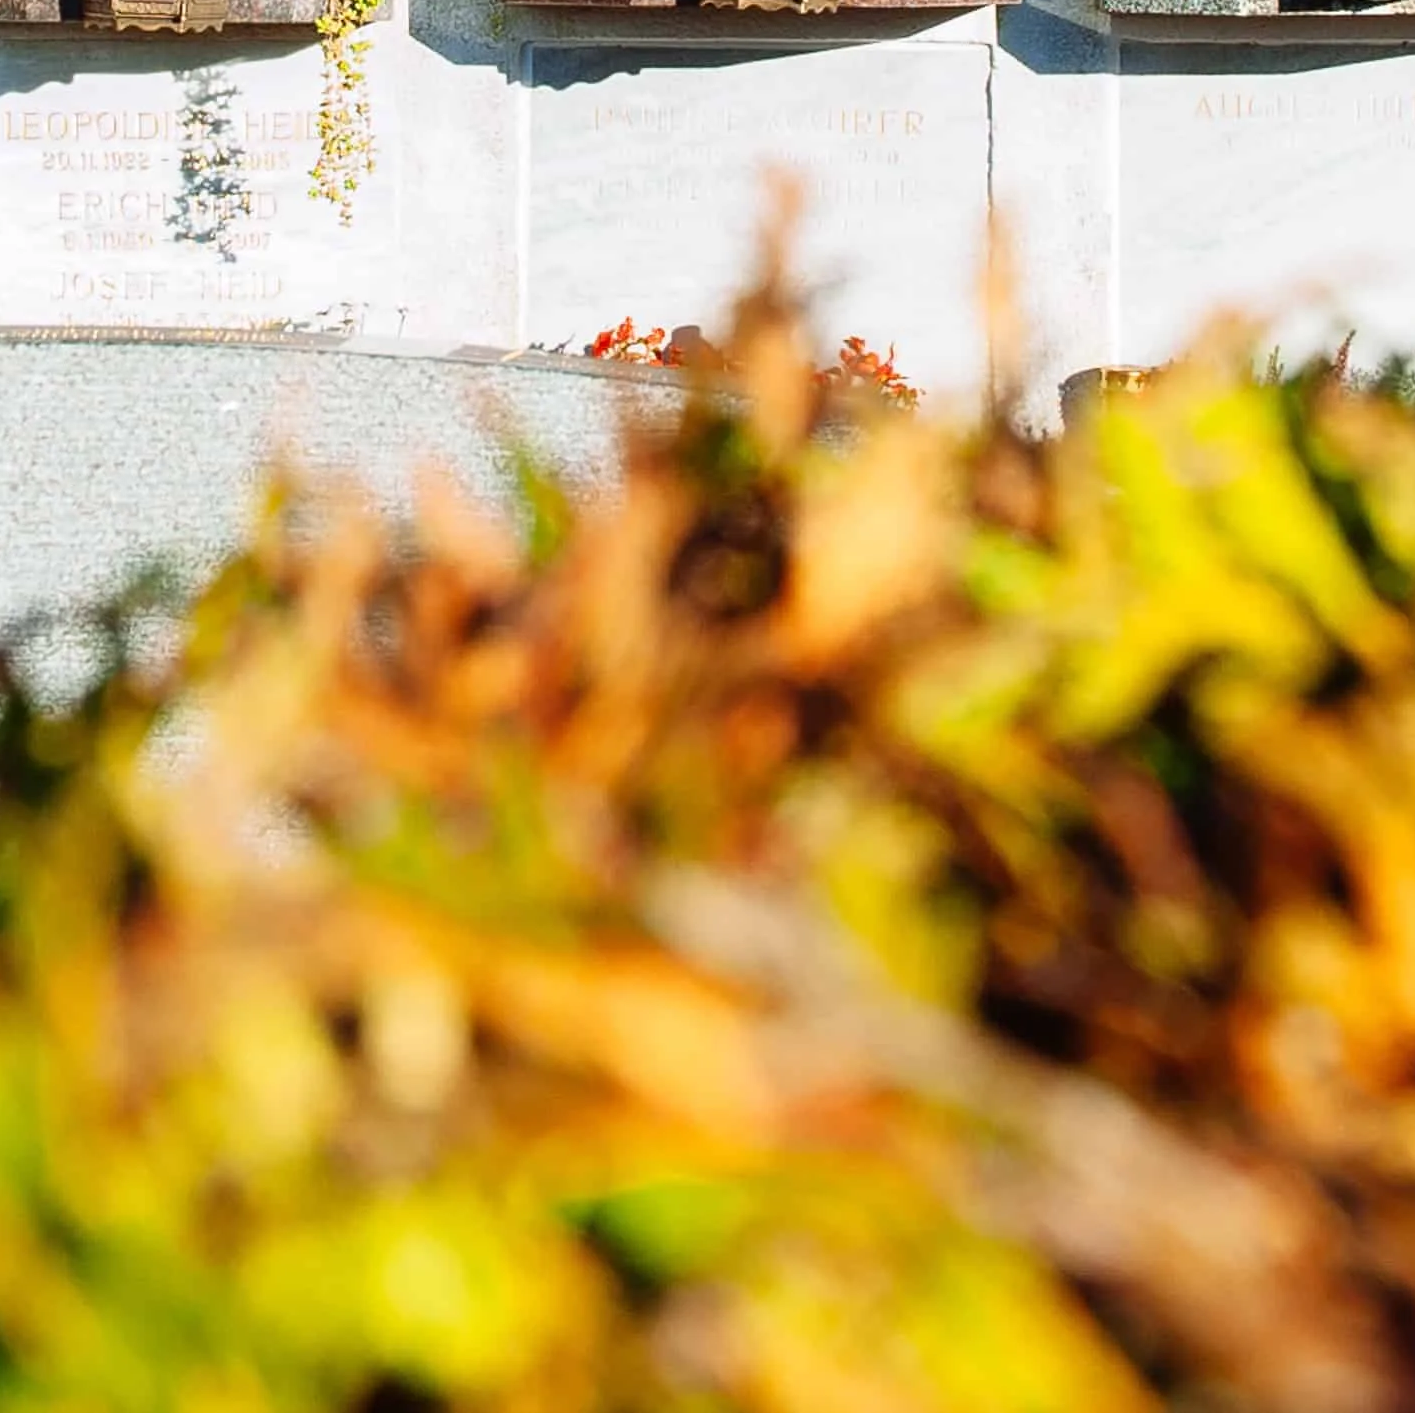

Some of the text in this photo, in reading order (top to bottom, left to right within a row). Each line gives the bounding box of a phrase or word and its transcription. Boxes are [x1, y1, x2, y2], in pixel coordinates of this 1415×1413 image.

[58, 192, 168, 221] ERICH
[51, 271, 285, 303] JOSEF HEID
